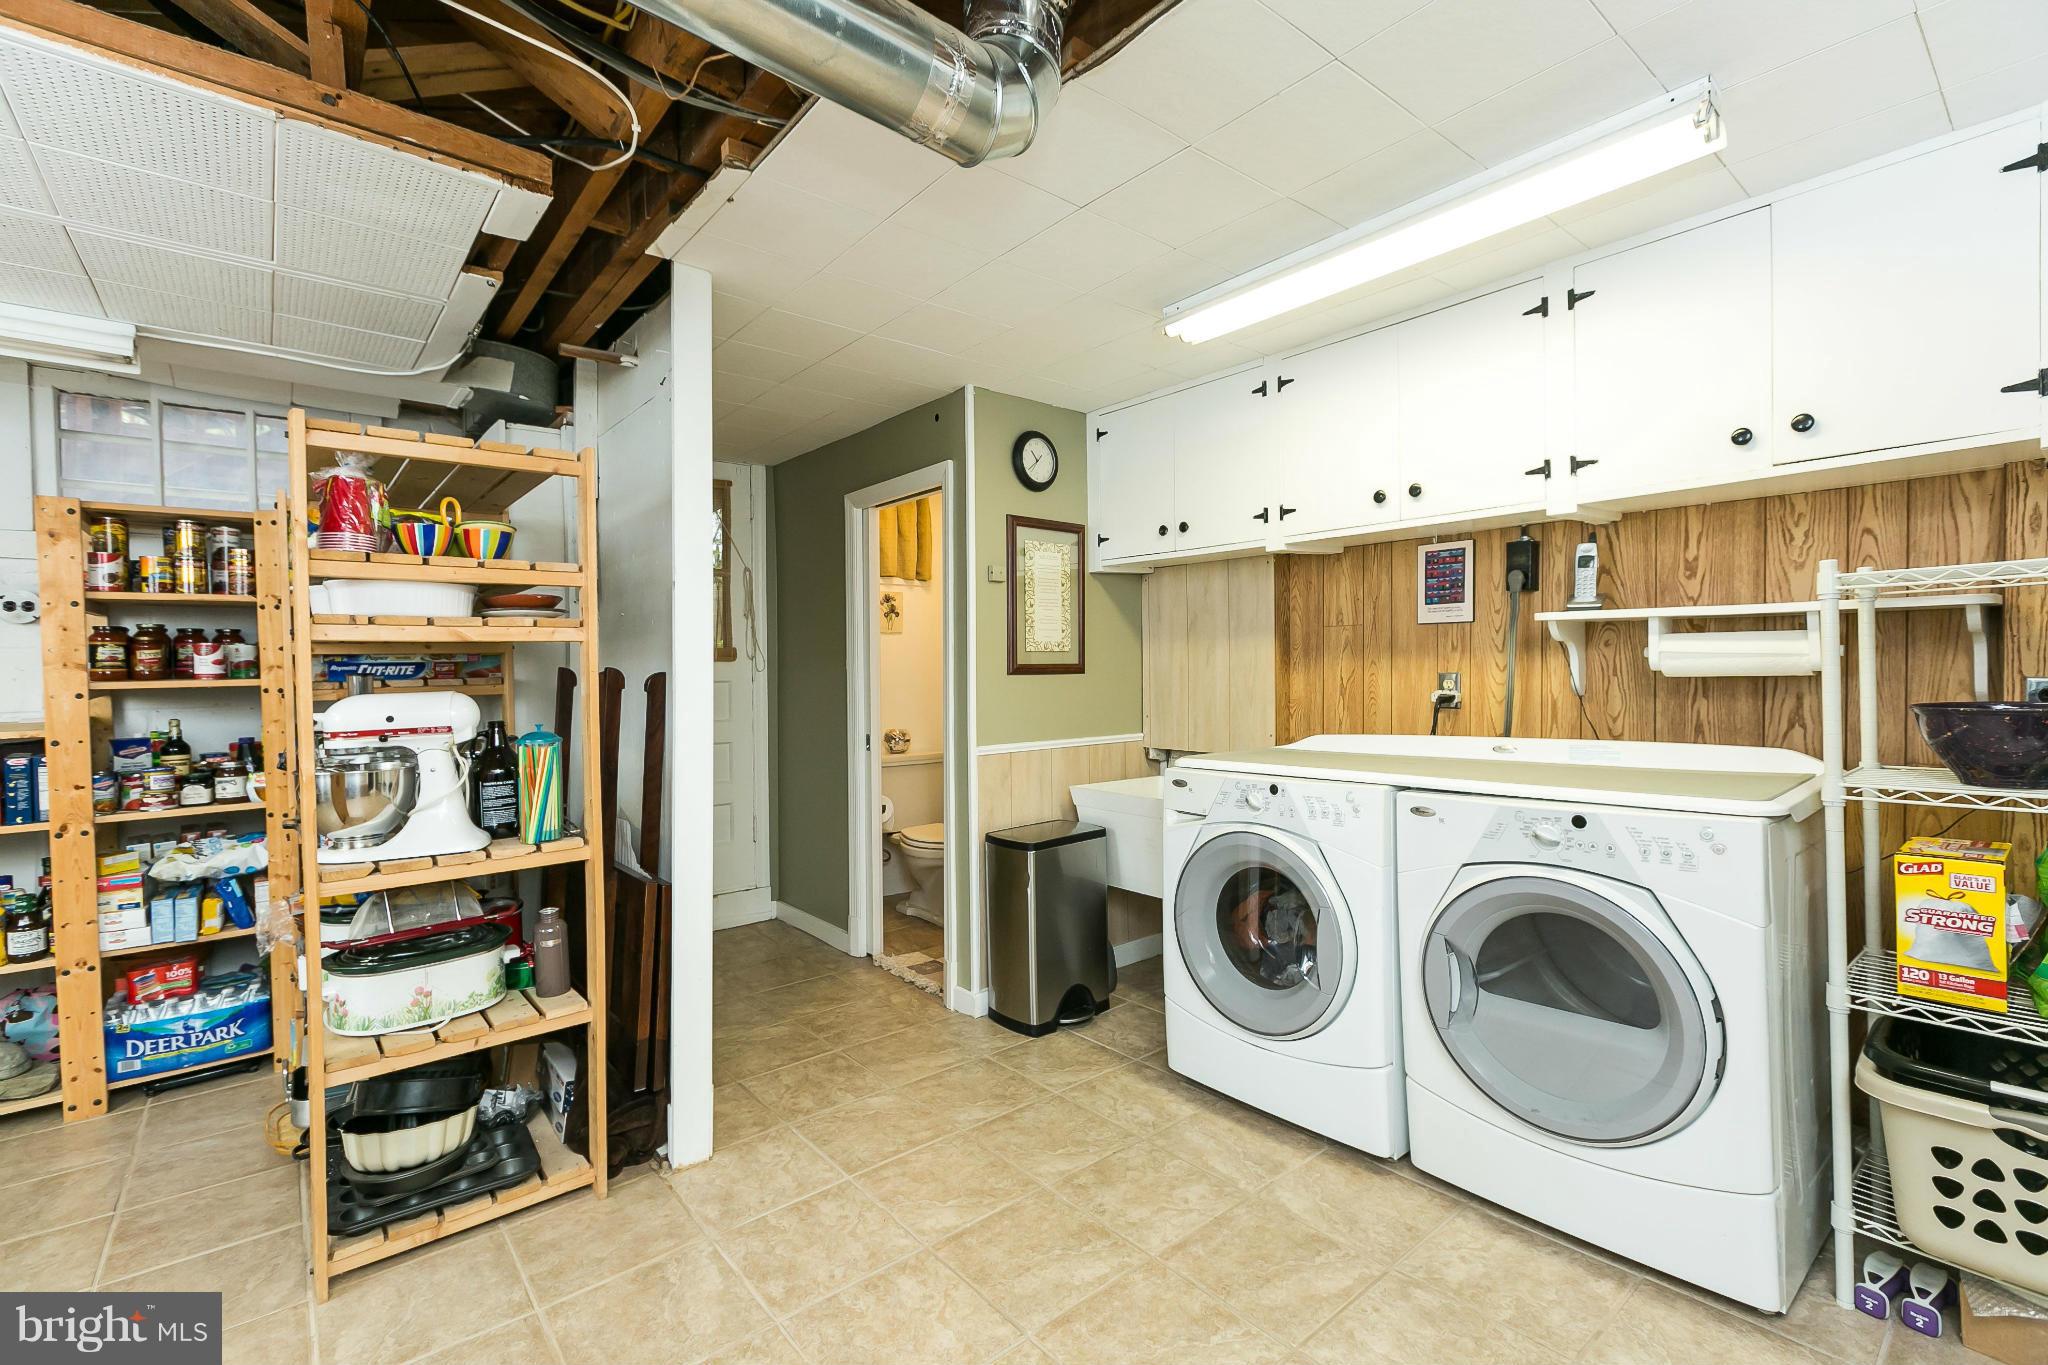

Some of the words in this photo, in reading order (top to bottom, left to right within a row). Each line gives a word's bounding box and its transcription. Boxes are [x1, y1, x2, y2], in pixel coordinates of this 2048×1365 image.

[1900, 863, 1943, 874] GLAD
[1954, 880, 1992, 891] VALUE
[1905, 909, 1994, 933] STRONG
[1920, 908, 1995, 922] GUARANTEED
[165, 967, 193, 979] 100%
[1901, 967, 1930, 981] 120
[1938, 972, 1948, 981] 13
[1949, 975, 1976, 985] Gallon
[126, 1035, 187, 1058] DEER
[190, 1017, 247, 1047] PARK
[1865, 1300, 1874, 1311] 2
[1915, 1317, 1924, 1329] 2
